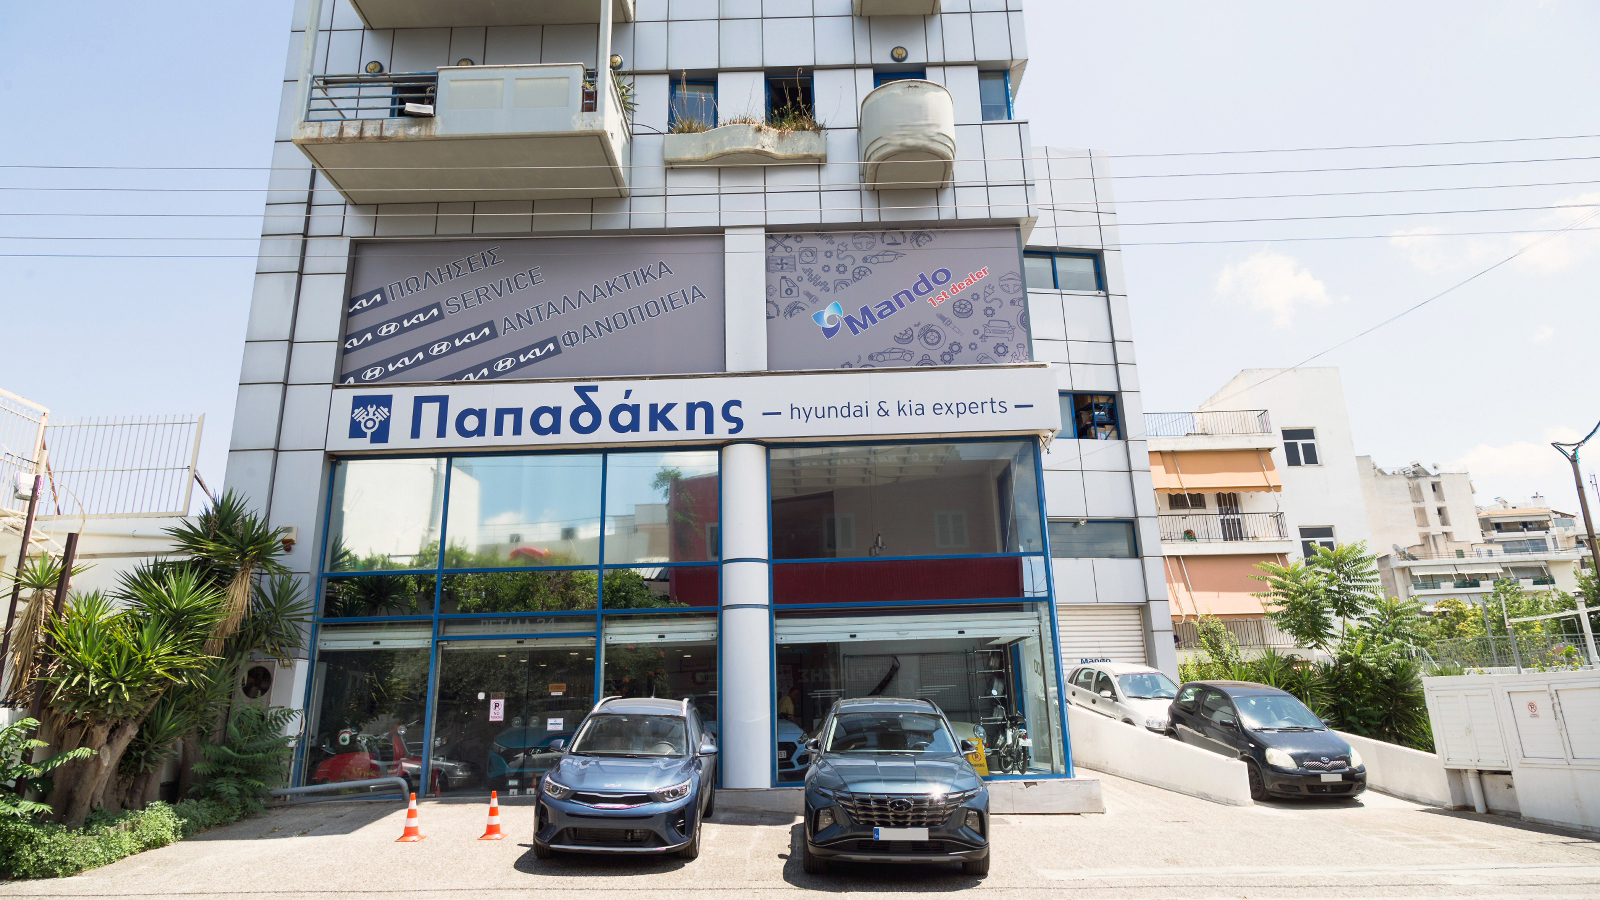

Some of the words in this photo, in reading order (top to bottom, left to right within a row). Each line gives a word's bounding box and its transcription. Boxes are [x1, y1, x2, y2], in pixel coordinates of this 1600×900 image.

[444, 266, 545, 315] SERVICE
[502, 260, 674, 336] ΑΝΤΑΛΛΑΚΤΙΚΑ
[843, 267, 952, 336] Mando
[928, 290, 951, 307] 1st
[949, 266, 989, 296] dealer
[561, 284, 707, 348] ΦΑΝΟΠΟΙΕΙΑ
[410, 385, 744, 439] Παπαδάκης
[790, 400, 869, 424] hyundai
[876, 401, 890, 418] &
[897, 399, 925, 417] kia
[932, 397, 1008, 419] experts
